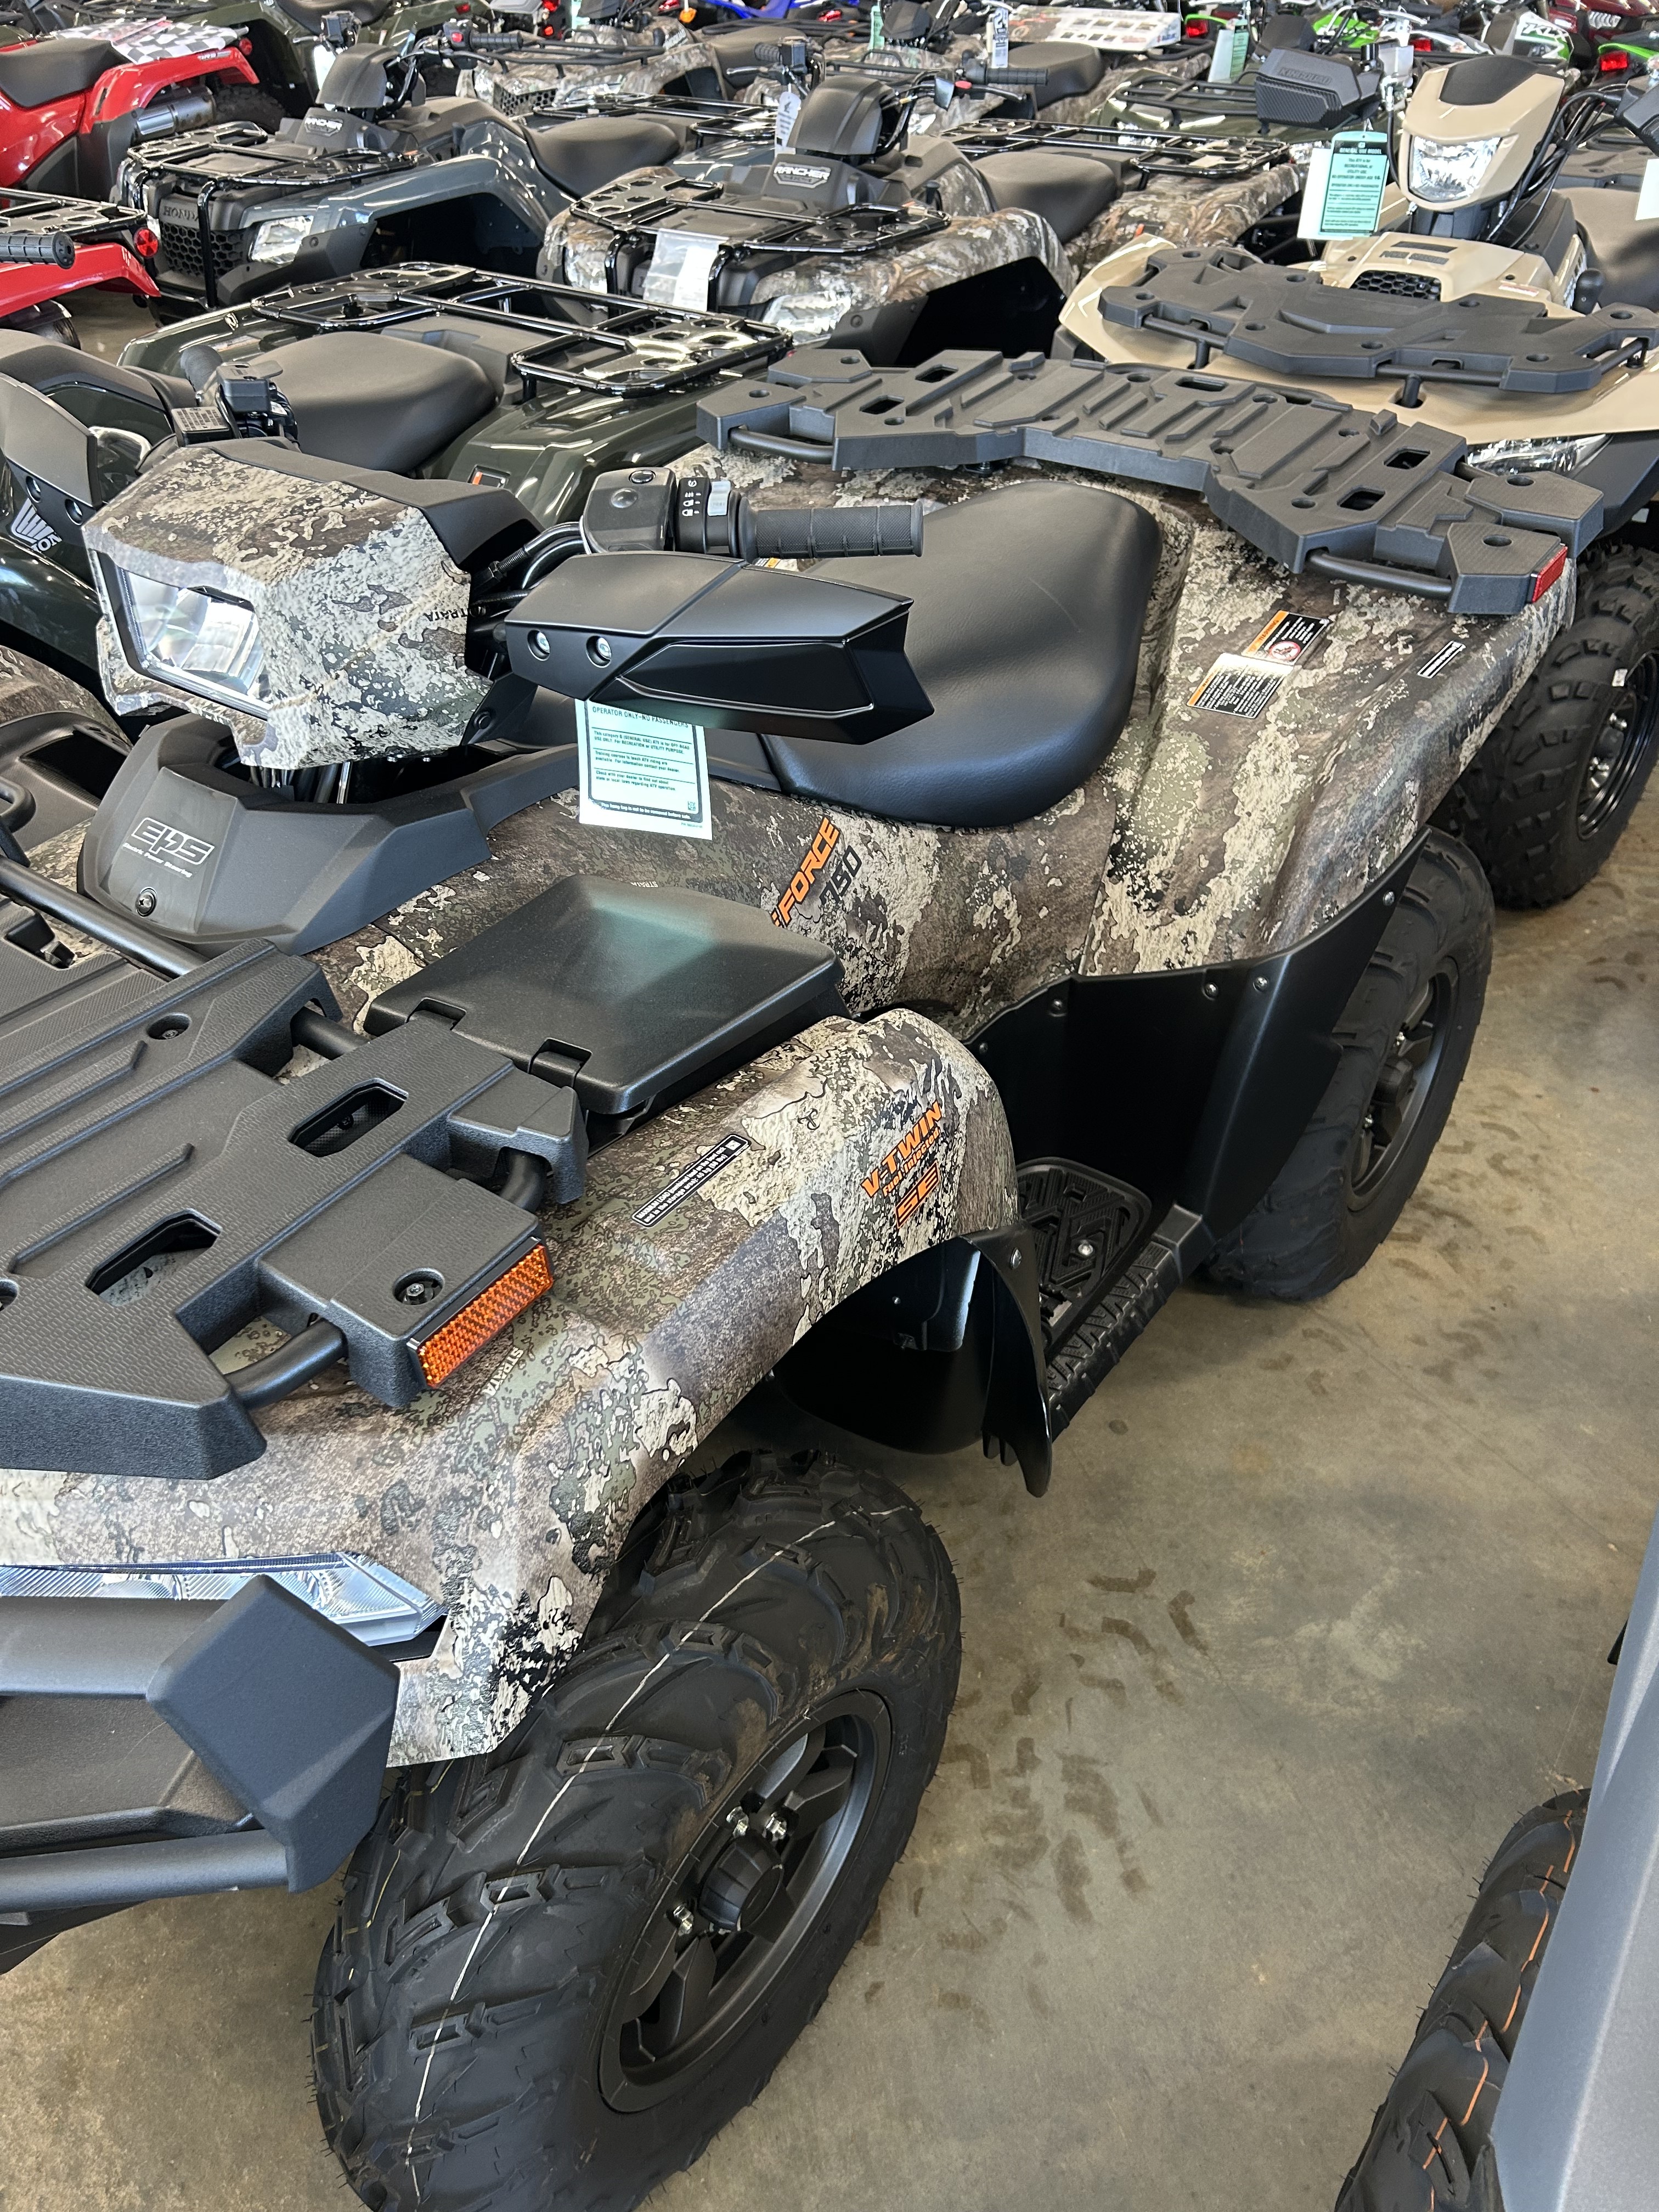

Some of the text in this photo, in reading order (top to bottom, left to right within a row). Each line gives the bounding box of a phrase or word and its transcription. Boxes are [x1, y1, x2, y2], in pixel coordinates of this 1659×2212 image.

[304, 117, 342, 131] RANCHER
[774, 166, 830, 180] RANCHER
[424, 608, 468, 622] TRATA
[592, 706, 622, 716] OPERATOR
[652, 715, 689, 728] PASSENGERS
[1373, 768, 1393, 796] STRATA
[123, 843, 193, 878] Electric Power Steering
[131, 817, 215, 865] EPS
[771, 817, 840, 927] iFORCE
[819, 845, 862, 905] 750
[861, 1099, 942, 1198] V-TWIN
[882, 1126, 940, 1197] Fuel Injected
[636, 1200, 659, 1218] MAXIMUM
[657, 1192, 670, 1203] LOAD
[686, 1169, 698, 1177] load
[706, 1153, 719, 1161] front
[644, 1213, 655, 1222] and
[667, 1189, 686, 1204] storage
[895, 1159, 940, 1229] SE
[482, 1346, 523, 1396] STRATA
